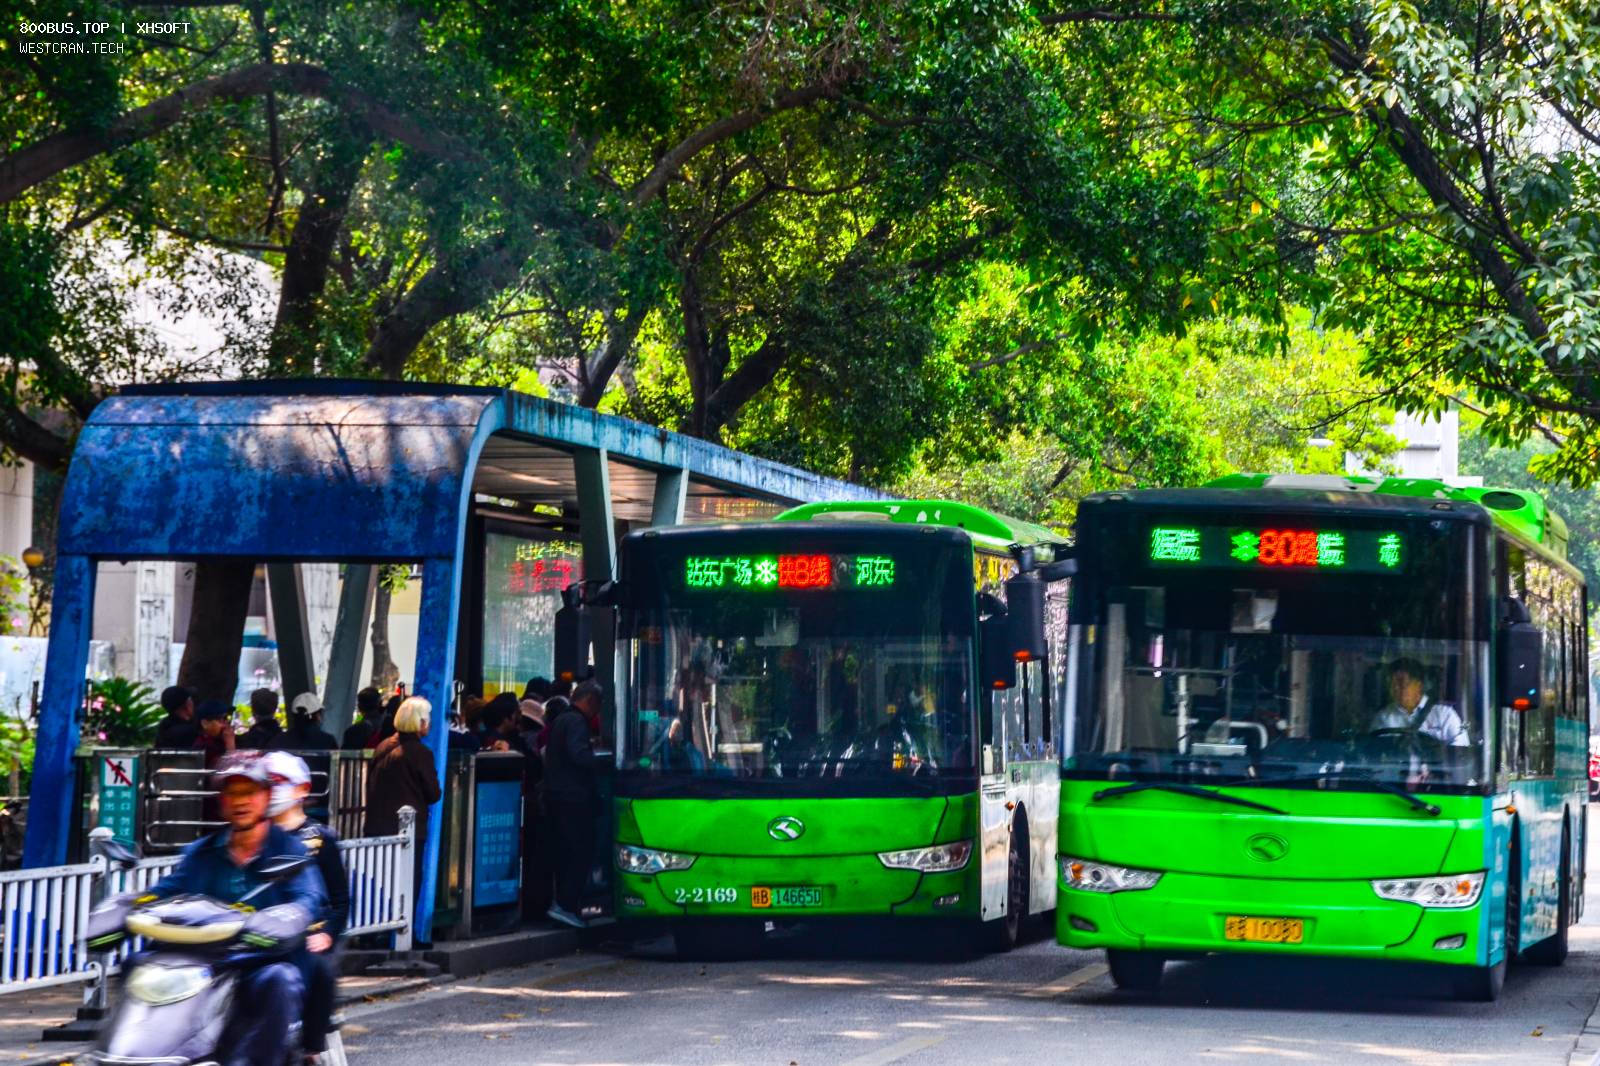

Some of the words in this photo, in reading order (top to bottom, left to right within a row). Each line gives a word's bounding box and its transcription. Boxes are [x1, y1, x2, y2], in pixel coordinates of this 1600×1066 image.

[686, 557, 752, 586] 站东广场
[856, 556, 895, 585] 河东
[674, 887, 738, 904] 2-2169
